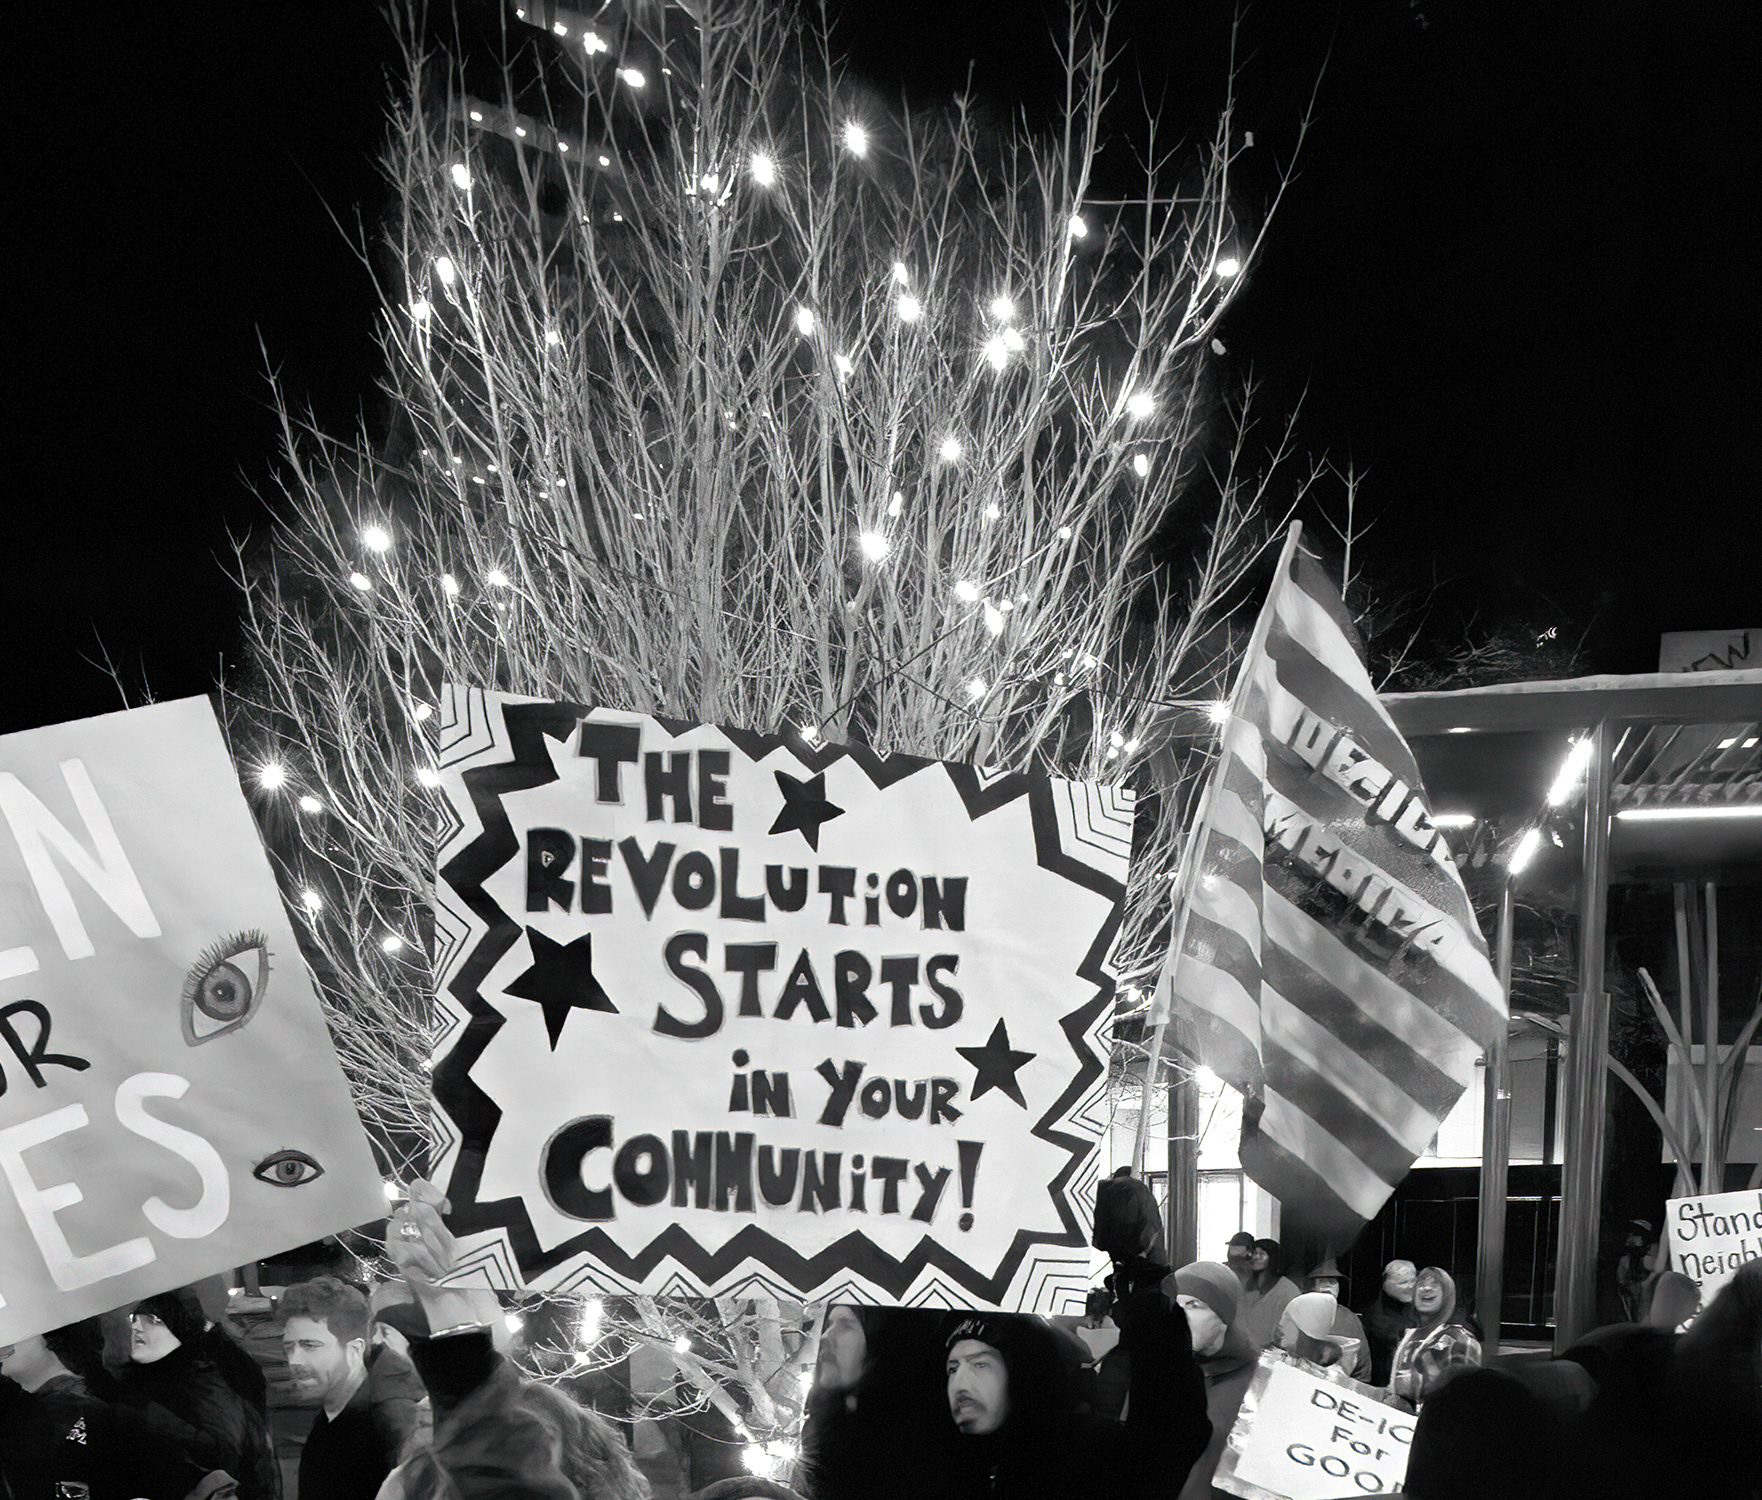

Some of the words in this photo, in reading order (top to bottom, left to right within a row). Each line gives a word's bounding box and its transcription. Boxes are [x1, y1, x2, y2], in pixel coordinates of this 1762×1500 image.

[576, 720, 734, 832] THE
[652, 930, 964, 1040] STARTS
[815, 1057, 965, 1127] YOUR
[0, 1071, 230, 1300] ES
